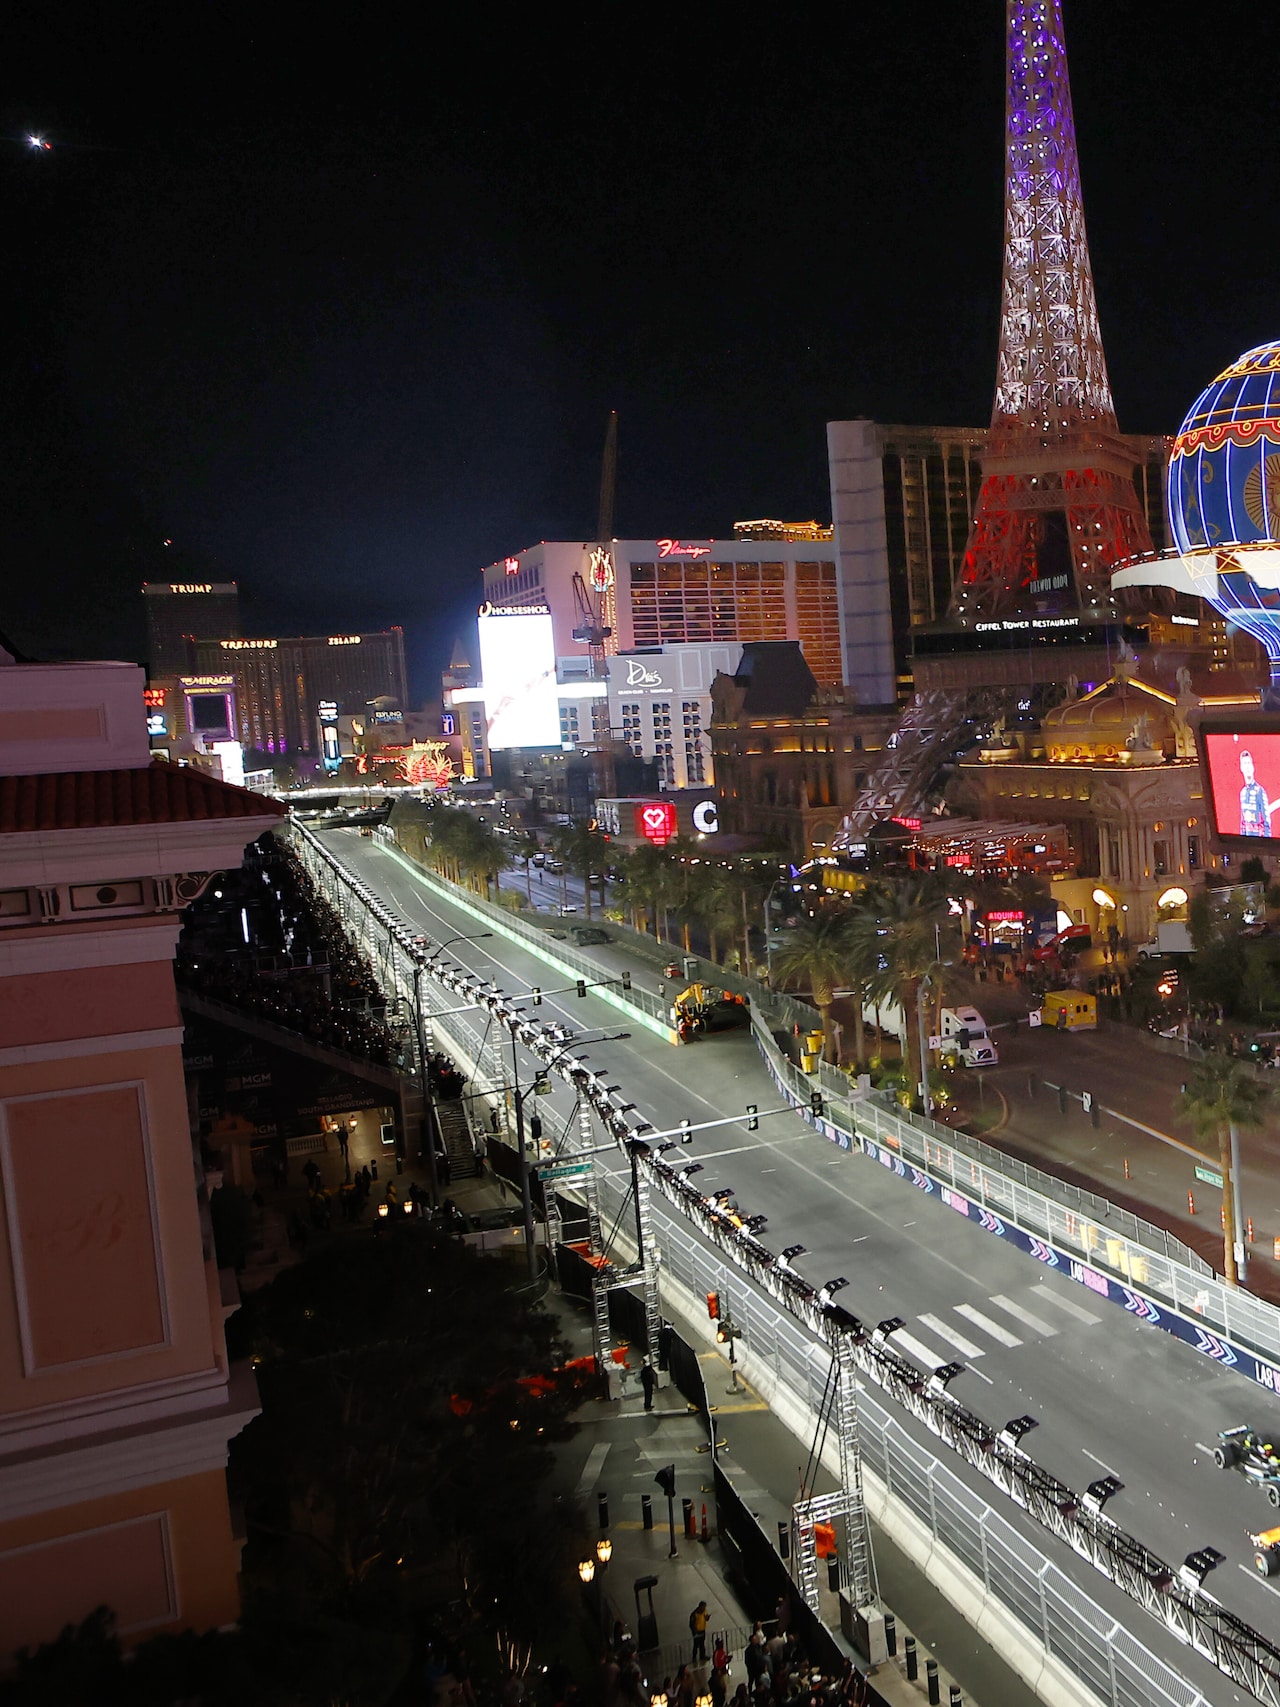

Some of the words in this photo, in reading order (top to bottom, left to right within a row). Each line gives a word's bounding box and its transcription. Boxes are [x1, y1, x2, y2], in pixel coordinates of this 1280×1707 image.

[656, 539, 710, 558] Flamingo
[170, 584, 213, 593] TRUMP
[491, 605, 549, 616] HORSESHOE
[220, 639, 278, 650] TREASURE
[327, 635, 361, 646] ISLAND
[191, 676, 233, 686] MIRAGE
[241, 1072, 272, 1085] MGM
[200, 1105, 219, 1117] GM
[1255, 1361, 1274, 1390] LAS
